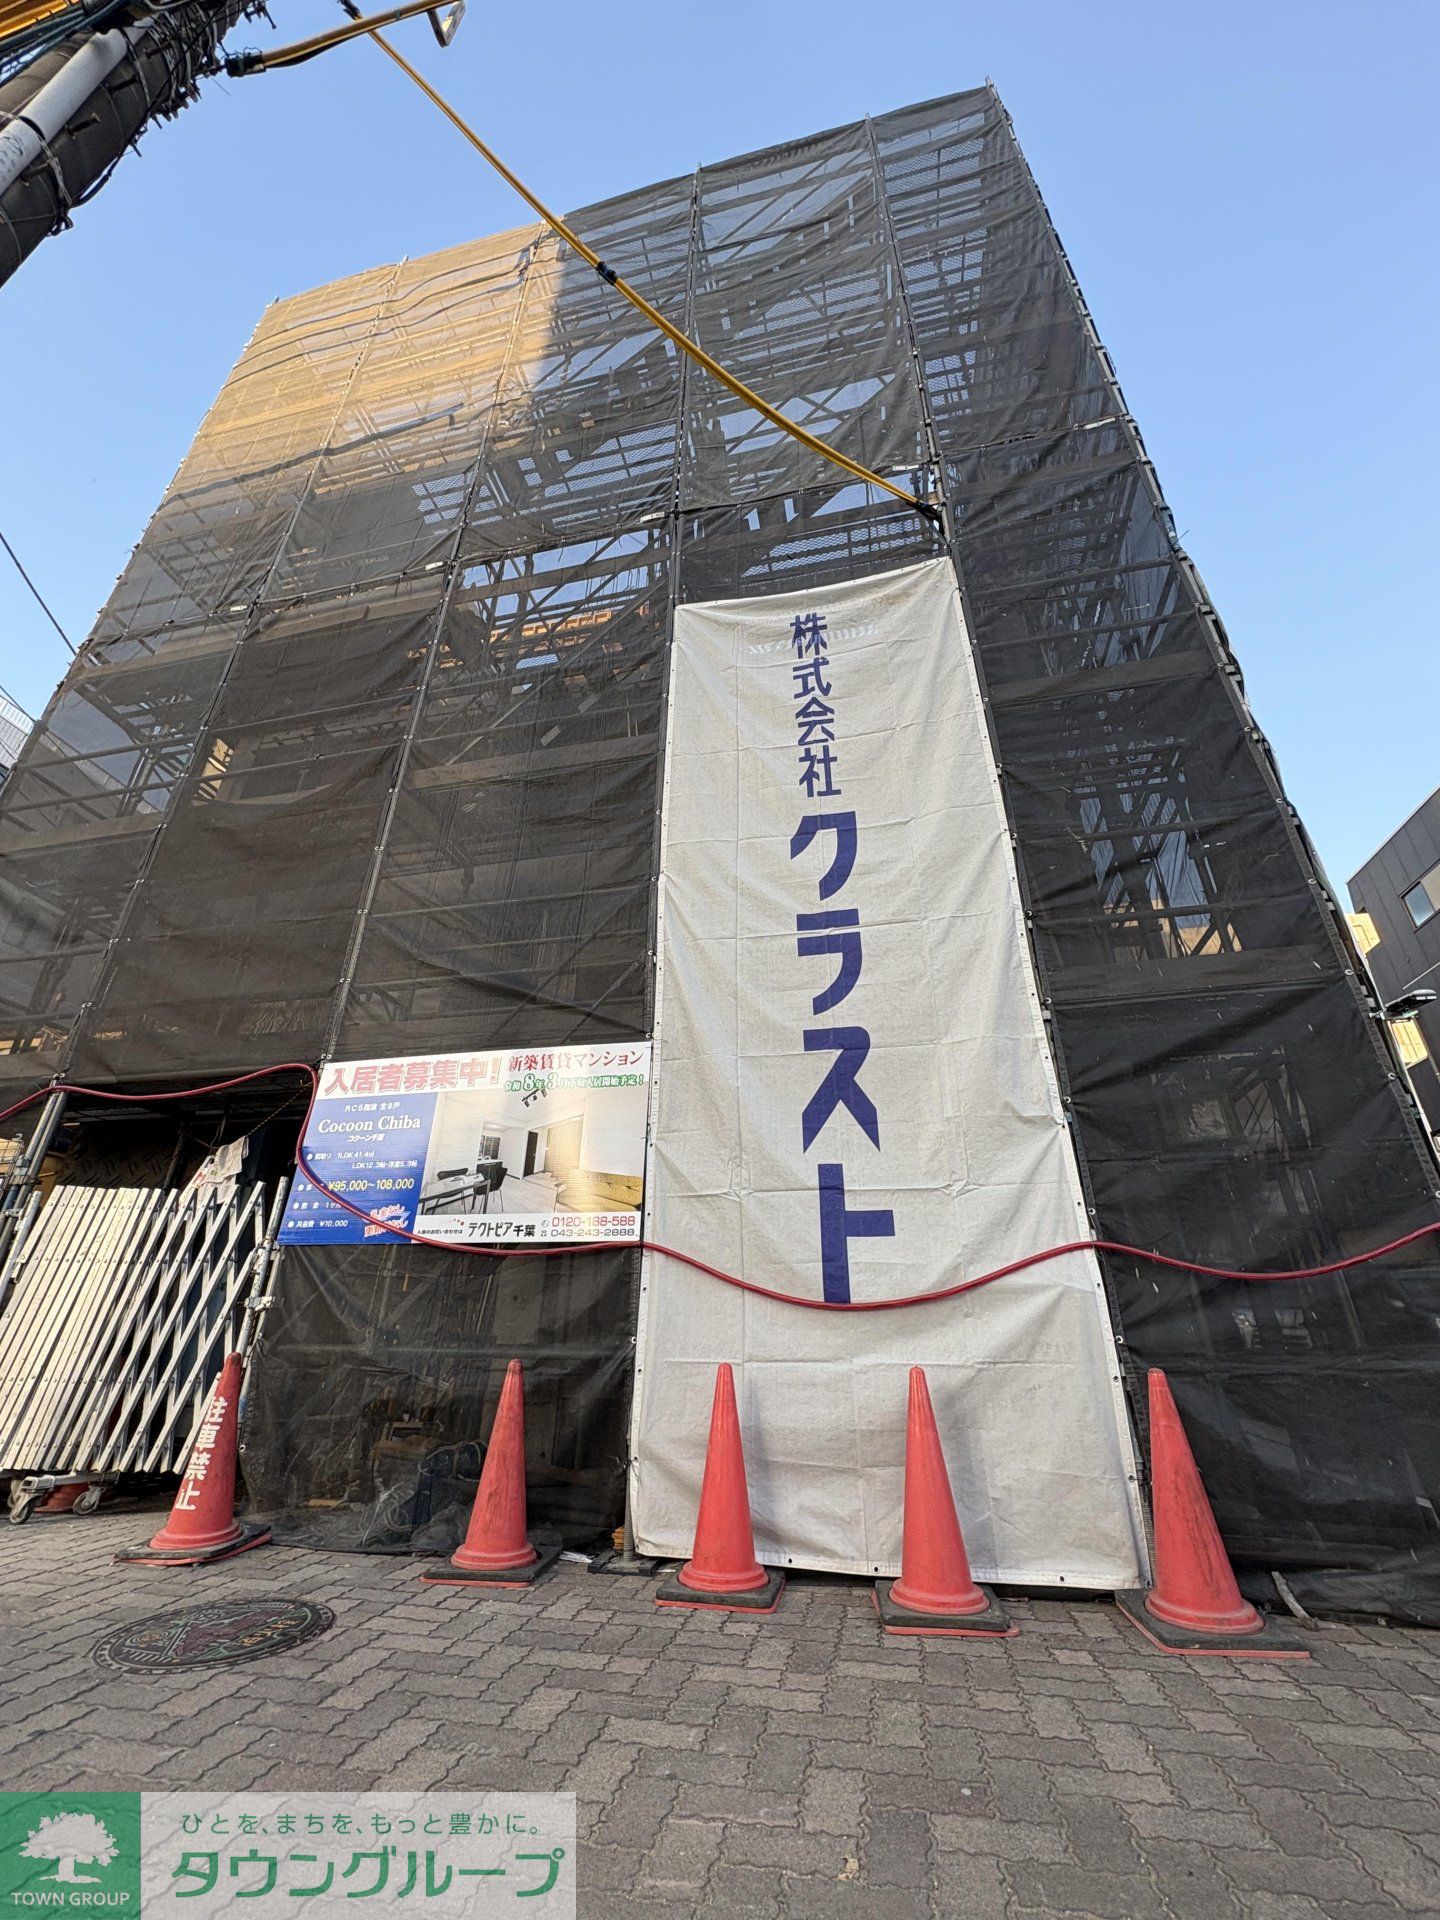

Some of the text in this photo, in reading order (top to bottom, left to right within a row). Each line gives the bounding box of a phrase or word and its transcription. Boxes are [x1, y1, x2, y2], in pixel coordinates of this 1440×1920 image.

[507, 1050, 644, 1072] 新築賃貸マンション
[318, 1114, 421, 1133] Cocoon Chiba
[468, 1222, 536, 1237] テクトピア千葉
[551, 1228, 634, 1237] 043-243-2888
